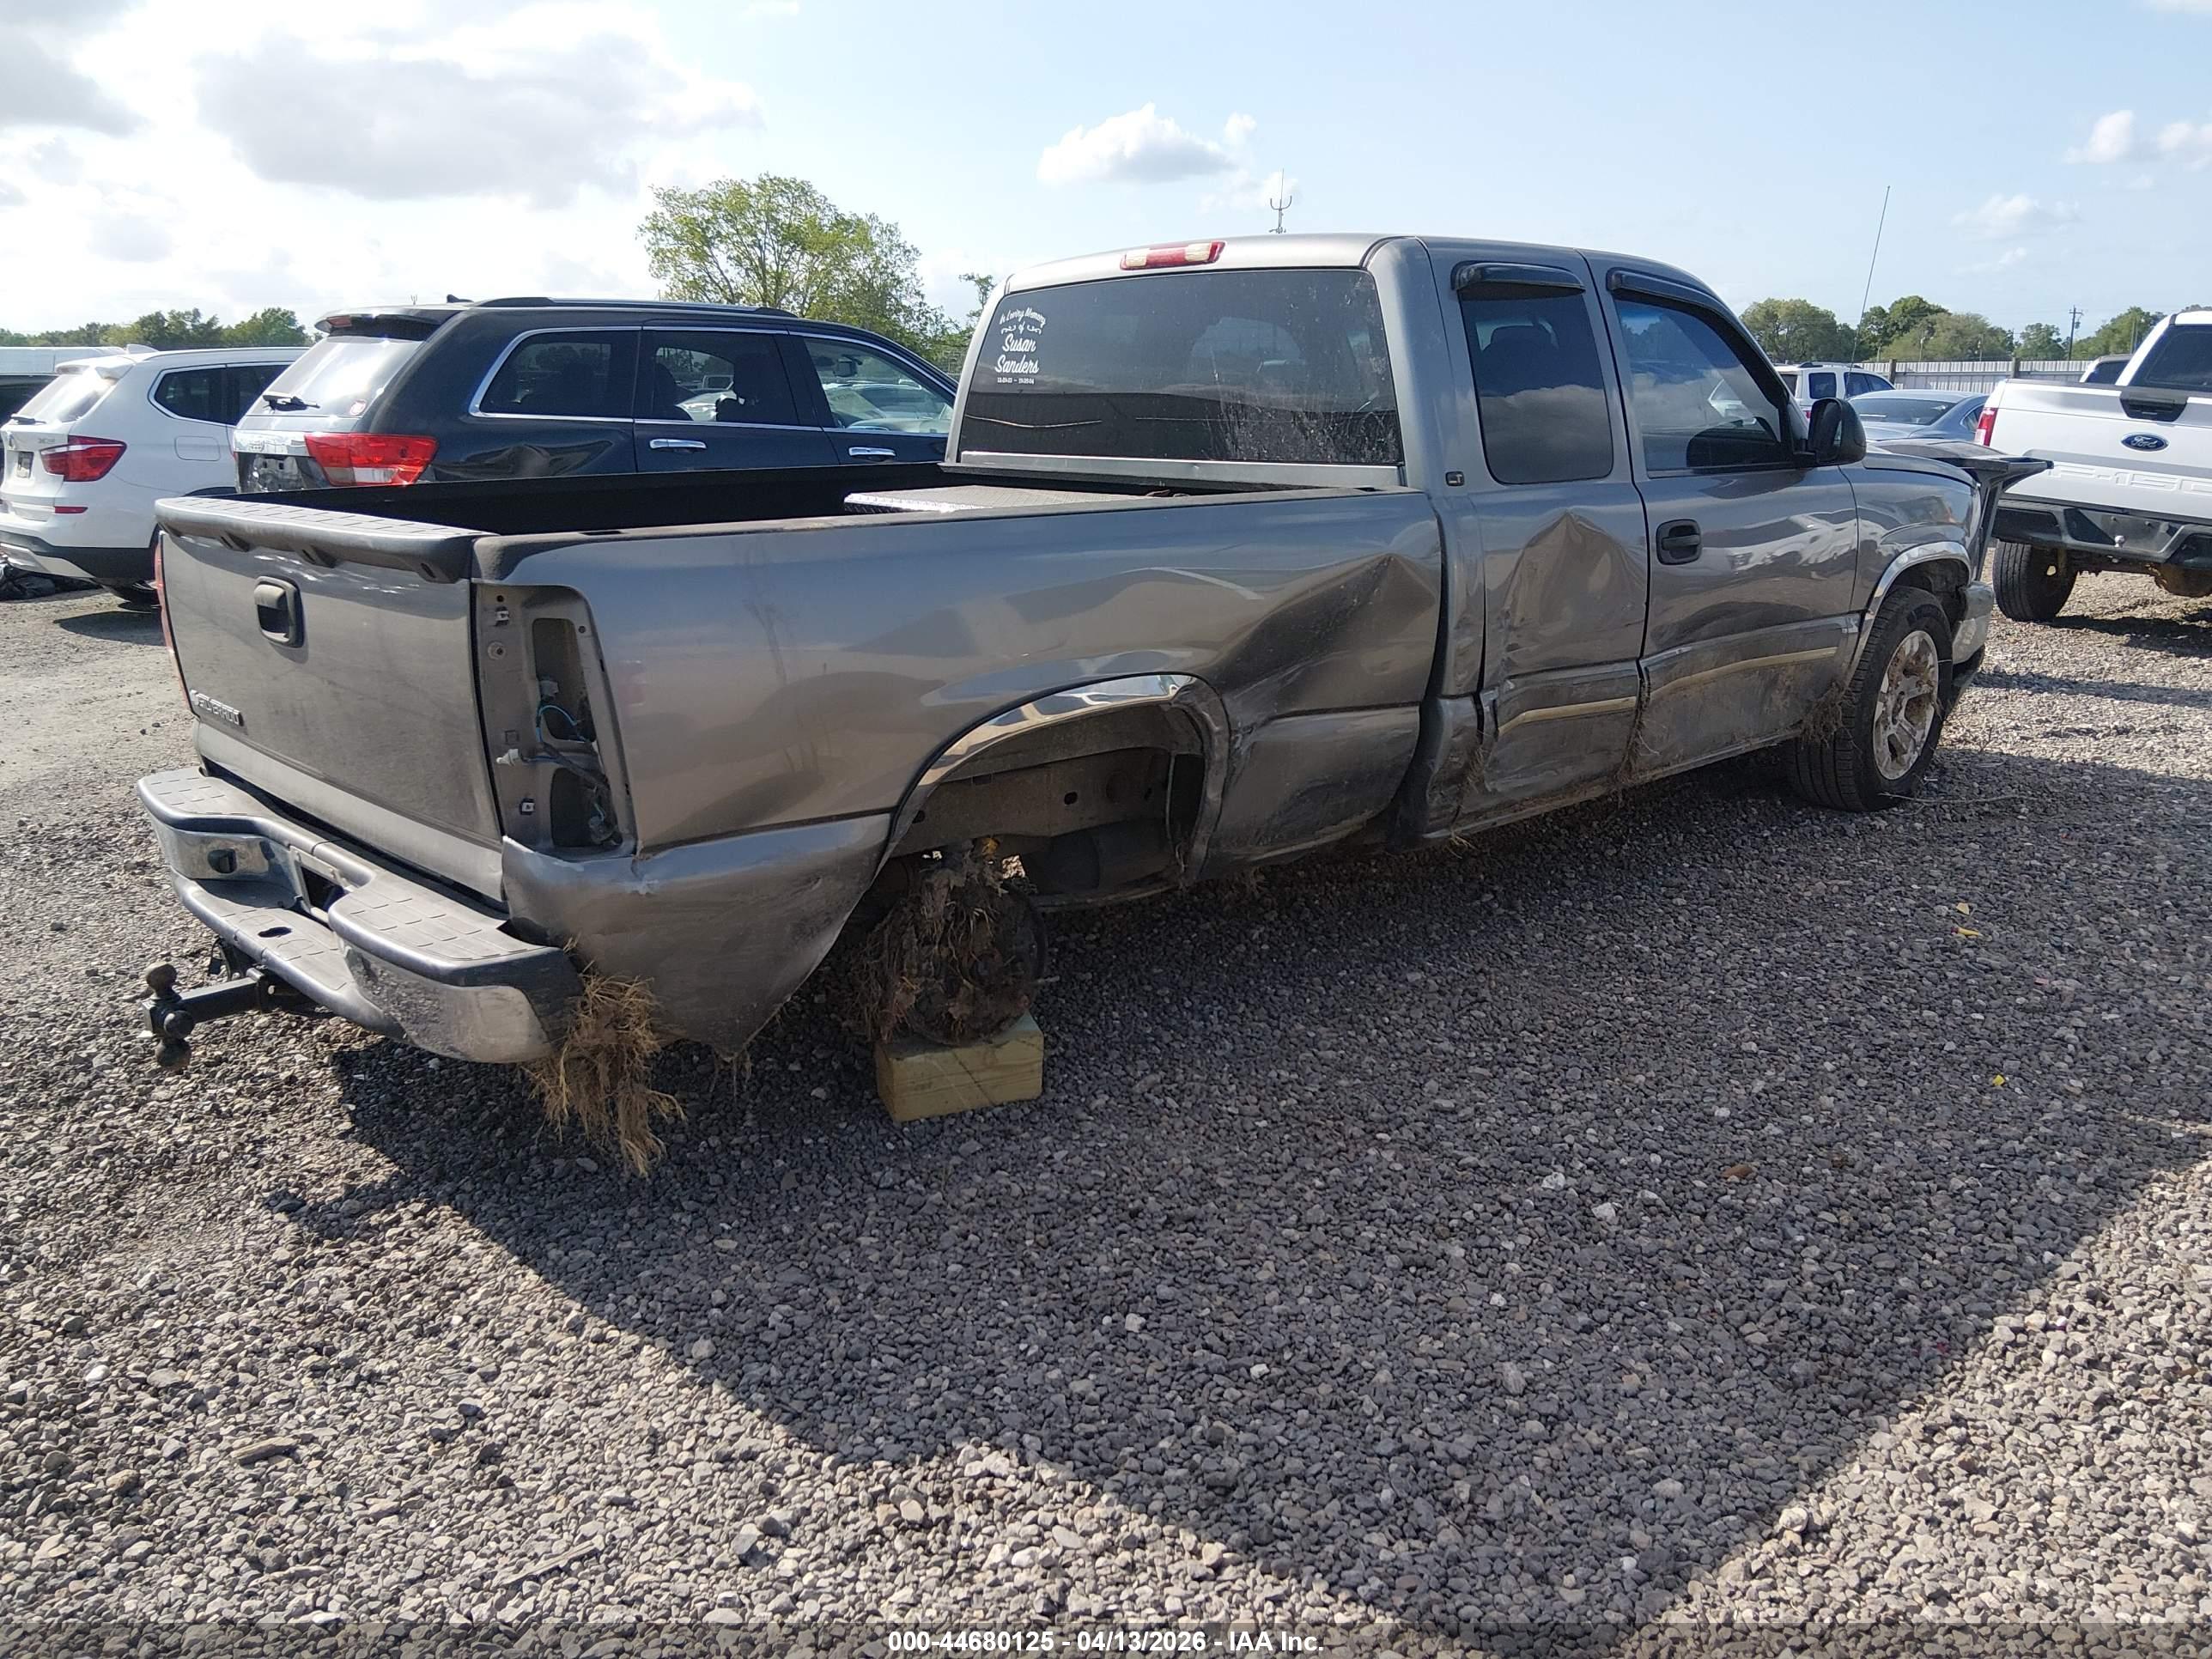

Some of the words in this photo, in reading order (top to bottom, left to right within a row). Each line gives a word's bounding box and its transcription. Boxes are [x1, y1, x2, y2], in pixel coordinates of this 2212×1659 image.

[1018, 320, 1026, 334] of
[1024, 307, 1046, 328] Memory
[1002, 333, 1036, 352] Susan
[994, 354, 1040, 374] Sanders
[2131, 435, 2158, 447] Ford
